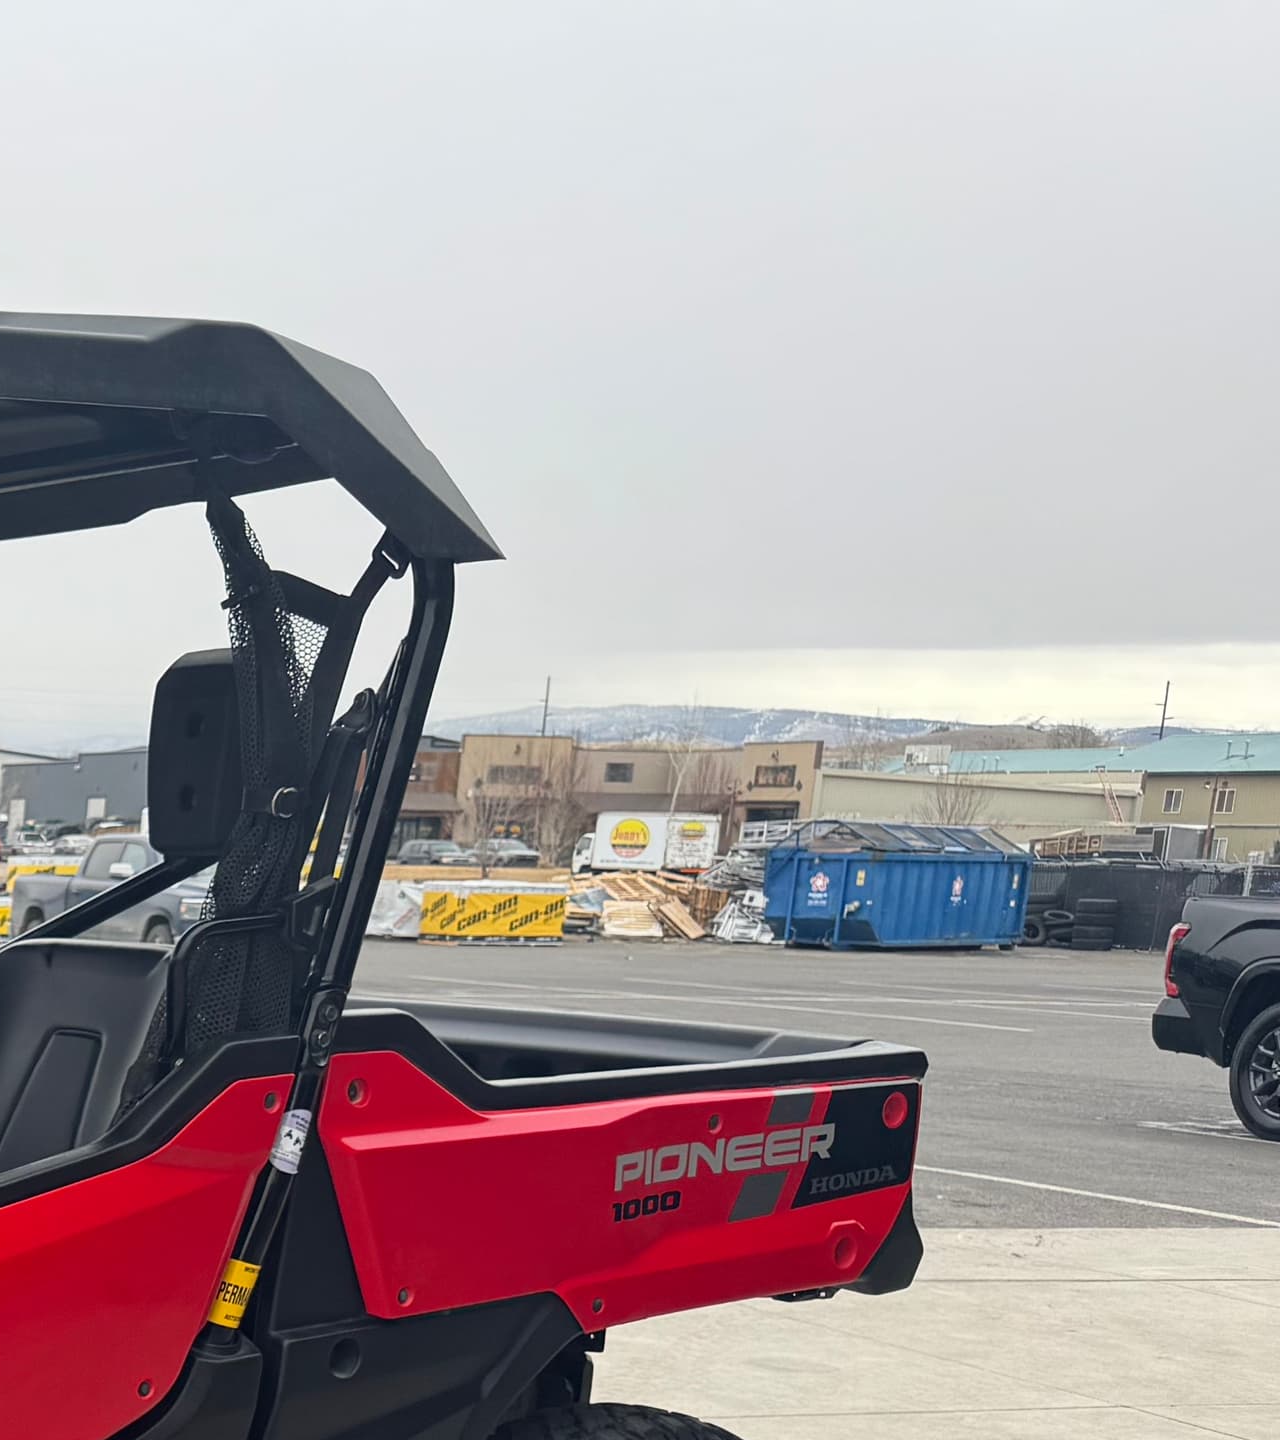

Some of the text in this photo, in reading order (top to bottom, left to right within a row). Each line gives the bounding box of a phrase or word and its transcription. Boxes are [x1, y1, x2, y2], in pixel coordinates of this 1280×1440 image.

[614, 1122, 836, 1192] PIONEER
[809, 1165, 898, 1196] HONDA
[612, 1190, 682, 1223] 1000
